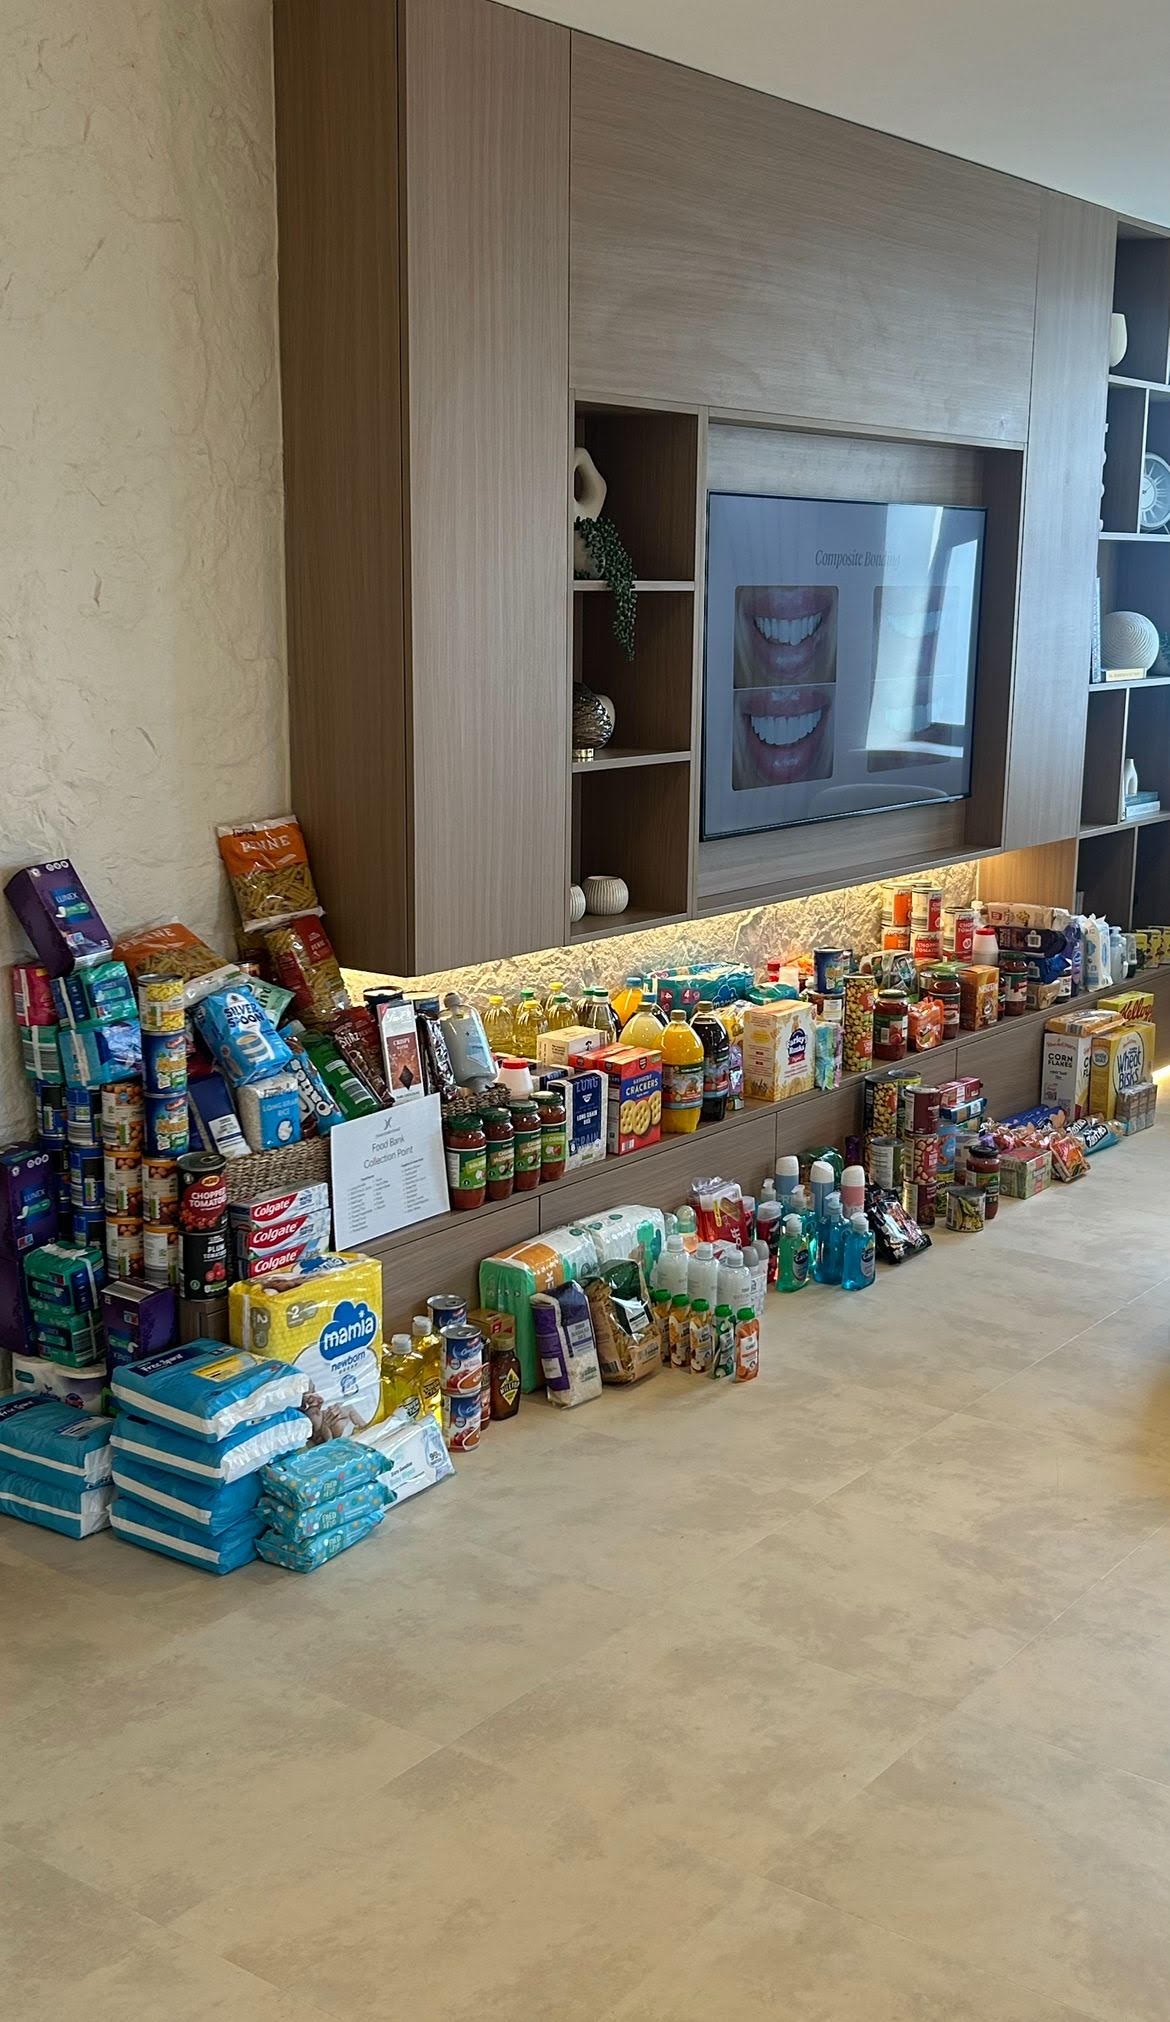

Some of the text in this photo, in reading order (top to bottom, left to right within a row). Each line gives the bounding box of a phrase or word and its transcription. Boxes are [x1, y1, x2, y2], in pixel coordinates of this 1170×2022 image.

[815, 549, 863, 569] Composite
[240, 835, 291, 853] PENNE
[223, 1002, 259, 1018] SILVER
[1047, 1060, 1073, 1068] FLAKES
[1048, 1052, 1073, 1062] CORN
[1116, 1048, 1142, 1074] Wheat
[625, 1078, 659, 1096] CRACKERS
[372, 1135, 405, 1152] Food Bank
[363, 1152, 397, 1169] Collection
[397, 1145, 414, 1158] Point
[254, 1199, 290, 1218] Colgate
[253, 1222, 297, 1243] Colgate
[254, 1251, 297, 1273] Colgate
[291, 1306, 300, 1319] 2
[323, 1310, 374, 1351] mamia
[330, 1351, 366, 1372] newborn
